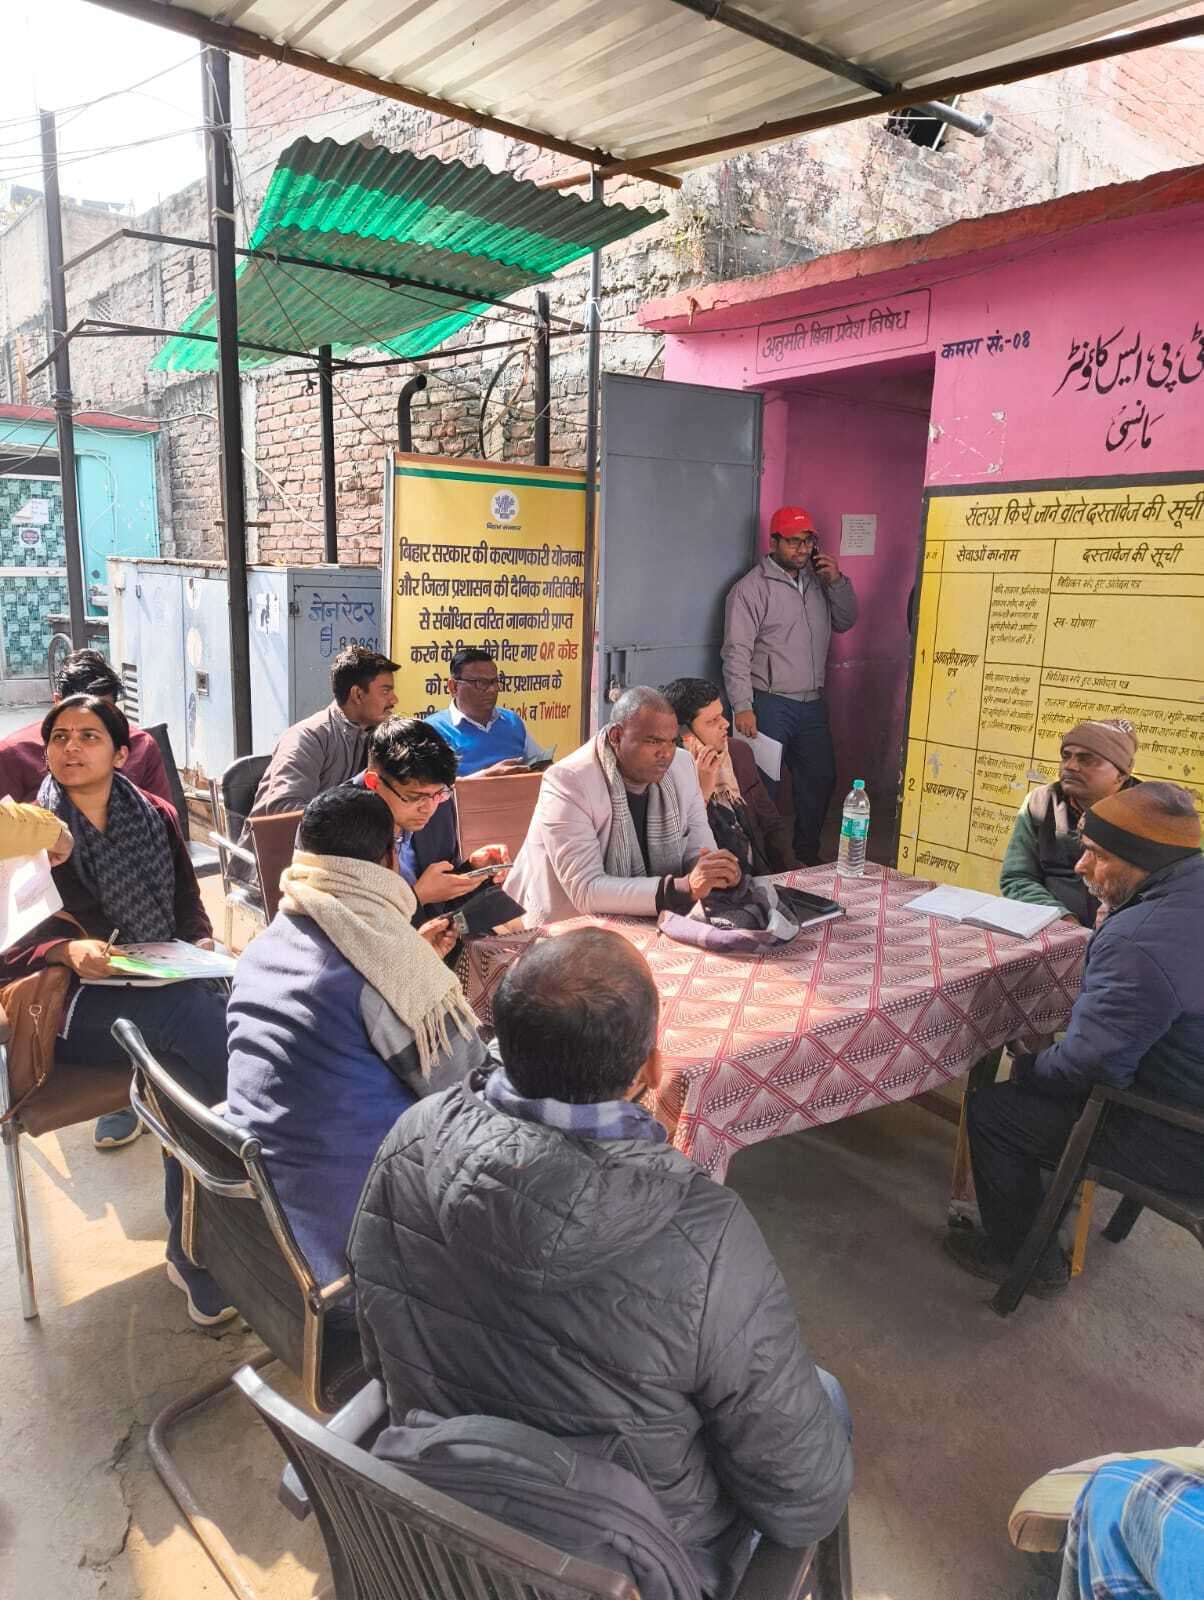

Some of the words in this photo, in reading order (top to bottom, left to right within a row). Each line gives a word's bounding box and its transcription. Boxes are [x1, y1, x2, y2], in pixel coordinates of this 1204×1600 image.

[762, 322, 808, 361] अनुमति
[810, 320, 835, 345] बिना
[835, 314, 865, 342] प्रवेश
[867, 306, 911, 336] निषेध
[941, 338, 984, 359] कमरा
[1003, 498, 1035, 525] किये
[1034, 496, 1061, 523] जाने
[1060, 495, 1089, 524] वाले
[1086, 494, 1145, 525] दस्तावेज
[1142, 493, 1167, 521] की
[399, 536, 432, 563] बिहार
[432, 543, 471, 563] सरकार
[472, 540, 488, 564] की
[489, 543, 550, 567] कल्याणकारी
[956, 544, 987, 562] सेवाओं
[987, 549, 1000, 561] का
[999, 549, 1021, 562] नाम
[1082, 542, 1132, 563] दस्तावेज
[1131, 542, 1149, 563] की
[1150, 542, 1184, 568] सूची
[397, 571, 421, 597] और
[421, 572, 449, 597] जिला
[451, 578, 492, 599] प्रशासन
[493, 574, 510, 597] की
[510, 574, 541, 599] दैनिक
[419, 607, 430, 631] से
[432, 605, 473, 631] संबंधित
[474, 607, 506, 631] त्वरित
[505, 607, 551, 631] जानकारी
[551, 612, 574, 632] प्राप्त
[1069, 612, 1097, 629] घोषणा
[410, 641, 440, 663] करने
[440, 641, 453, 662] के
[501, 639, 519, 662] दिए
[520, 645, 538, 662] गए
[539, 642, 555, 661] QR
[557, 639, 580, 660] कोड
[425, 673, 442, 696] को
[514, 674, 550, 694] प्रशासन
[551, 669, 564, 690] के
[529, 705, 537, 721] व
[539, 702, 571, 720] Twitter
[908, 778, 915, 791] 2
[956, 788, 969, 801] पत्र
[902, 847, 908, 859] 3
[947, 861, 960, 874] पत्र
